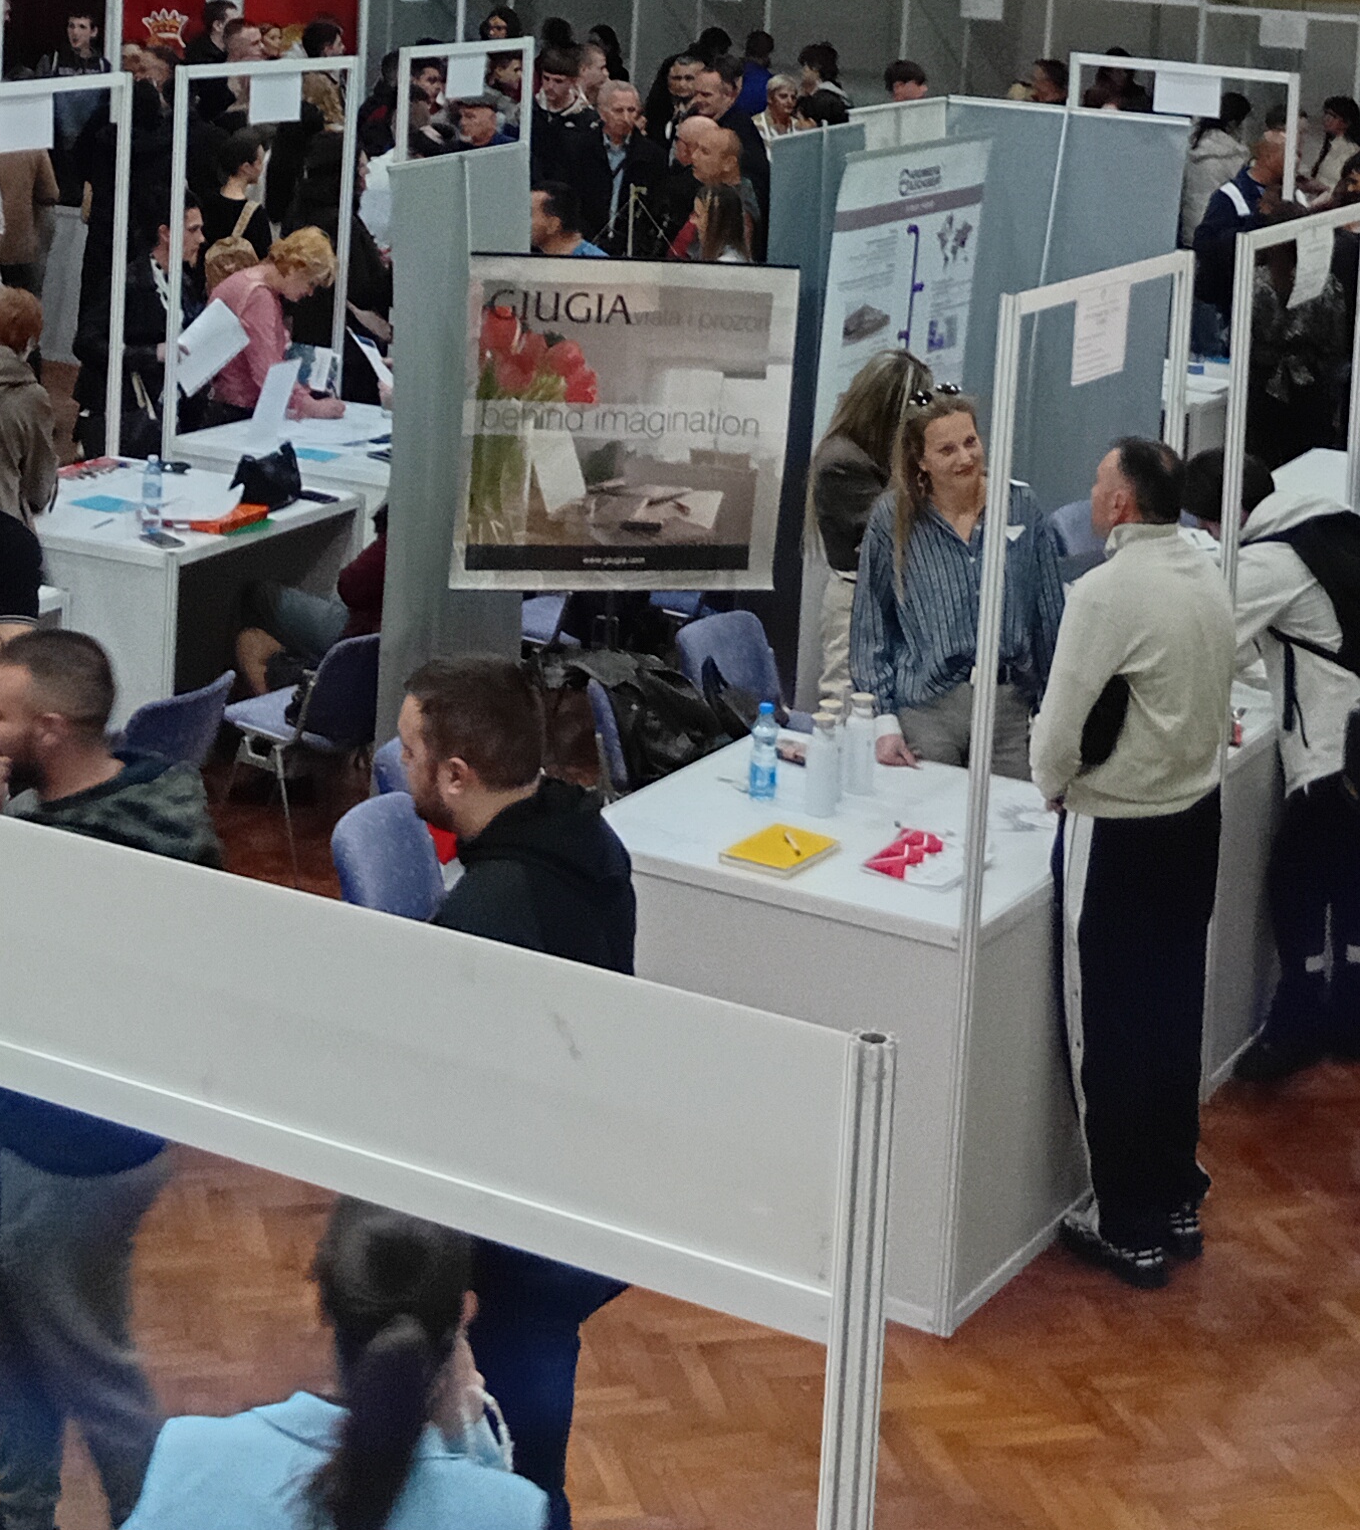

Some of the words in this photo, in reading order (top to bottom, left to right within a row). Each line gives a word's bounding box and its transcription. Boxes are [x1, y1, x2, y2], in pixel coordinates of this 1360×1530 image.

[489, 288, 633, 325] GIUGIA
[481, 400, 584, 432] behind
[594, 407, 760, 439] imagination
